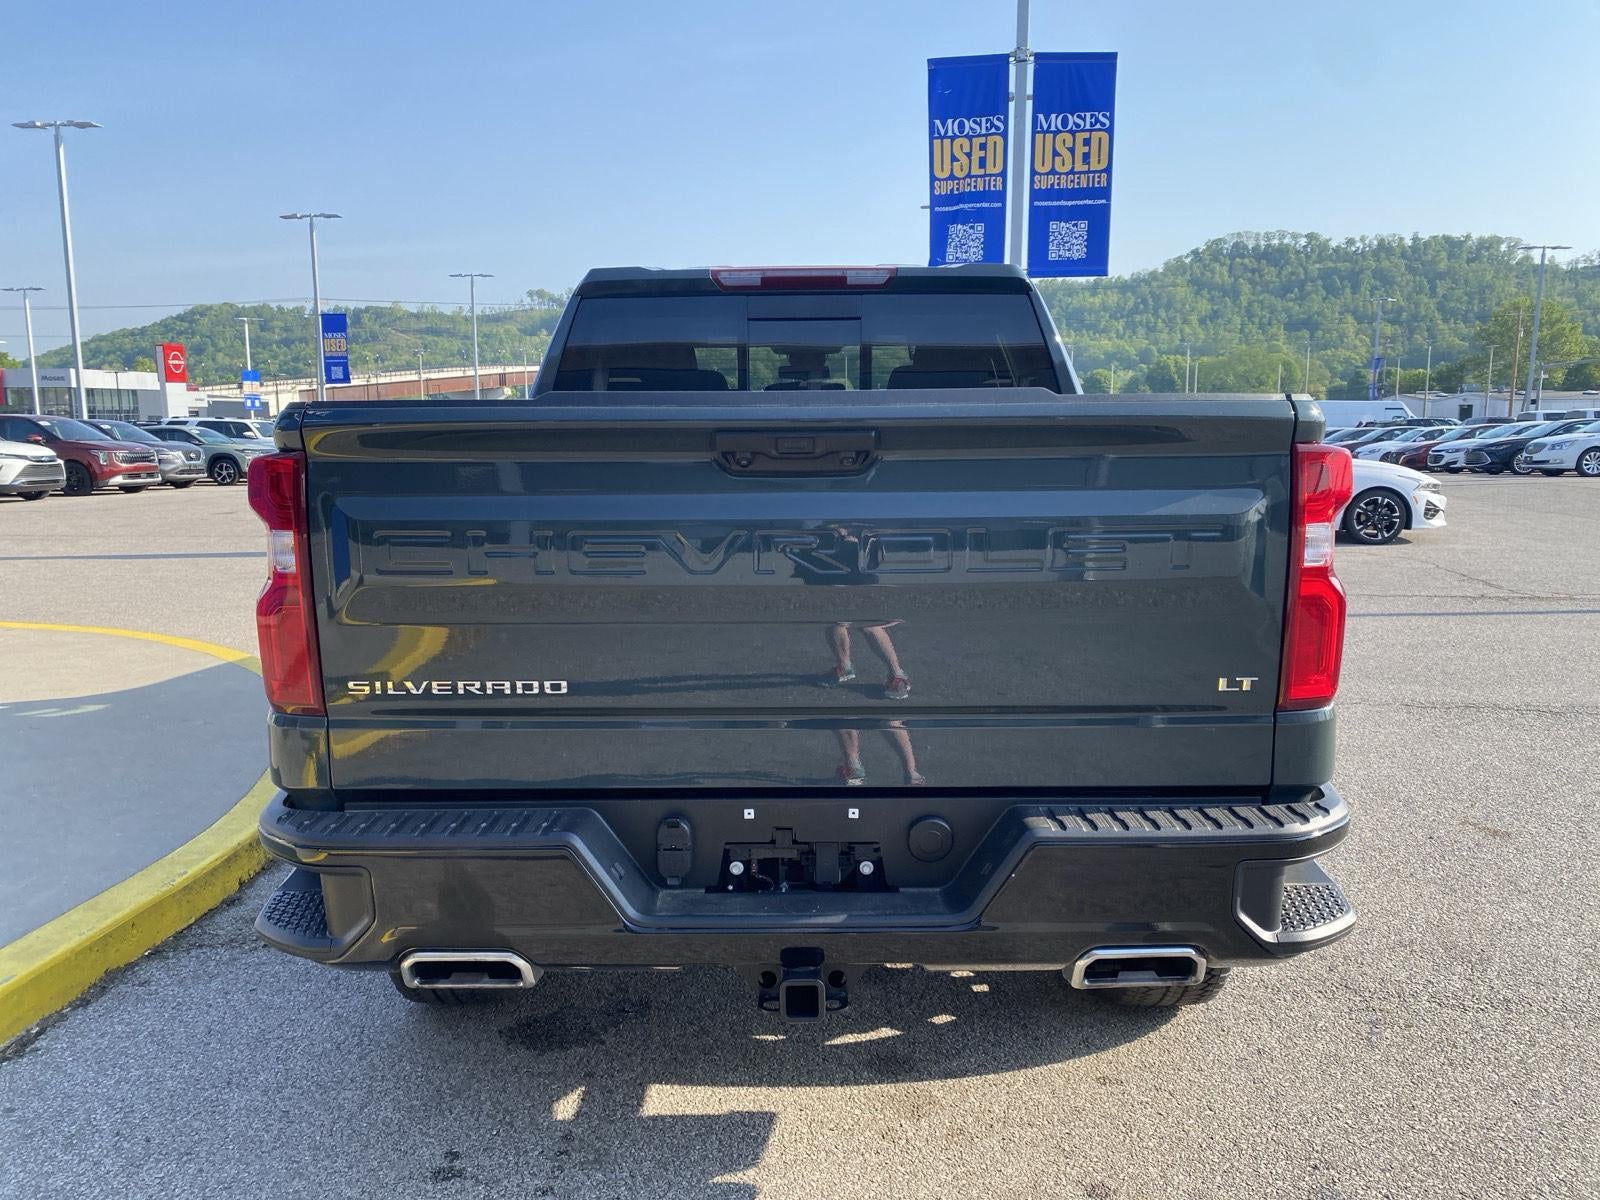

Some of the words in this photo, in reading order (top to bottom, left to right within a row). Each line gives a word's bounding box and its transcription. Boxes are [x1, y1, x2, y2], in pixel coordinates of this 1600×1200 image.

[933, 114, 1005, 137] MOSES
[1037, 111, 1110, 132] MOSES
[933, 136, 1004, 179] USED
[1034, 131, 1109, 174] USED
[934, 176, 1003, 195] SUPERCENTER
[1033, 173, 1108, 190] SUPERCENTER
[1033, 198, 1107, 207] mosesusedsupercenter.com
[324, 338, 347, 352] USED
[371, 523, 1225, 576] CHEVROLET
[347, 679, 569, 695] SILVERADO
[1217, 676, 1259, 692] LT
